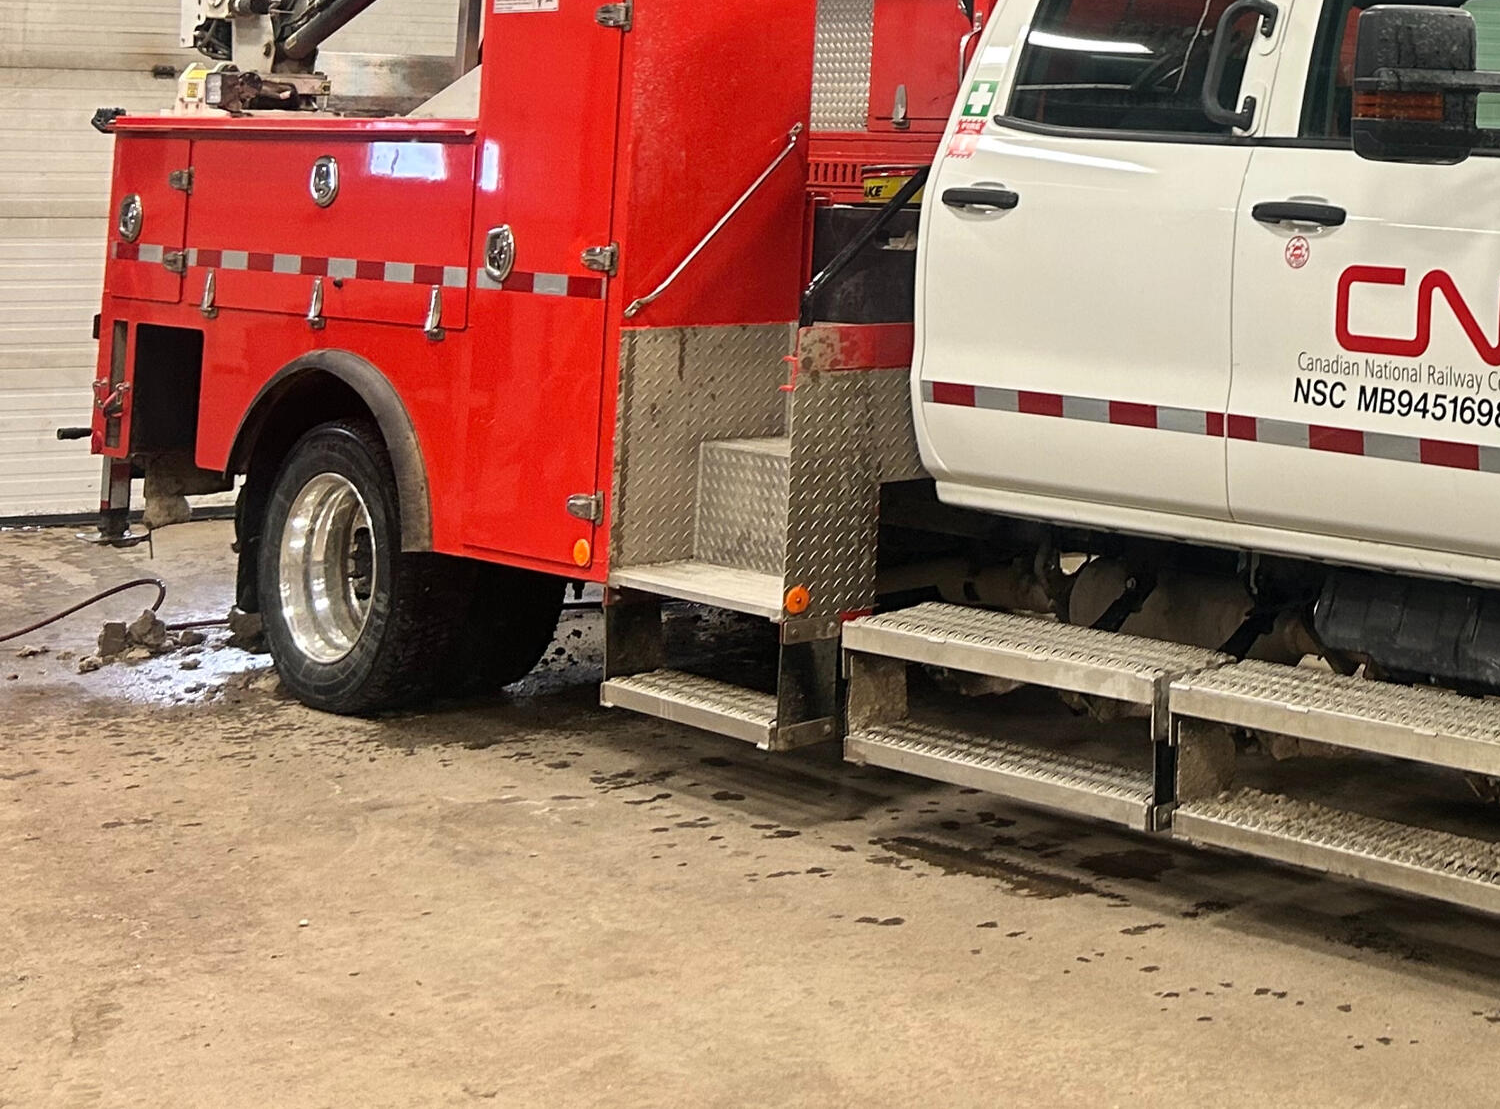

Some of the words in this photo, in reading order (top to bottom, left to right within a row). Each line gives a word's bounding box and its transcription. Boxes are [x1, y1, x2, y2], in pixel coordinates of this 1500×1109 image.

[1297, 351, 1360, 377] Canadian
[1364, 358, 1423, 384] National
[1427, 365, 1484, 395] Railway
[1293, 377, 1347, 409] NSC
